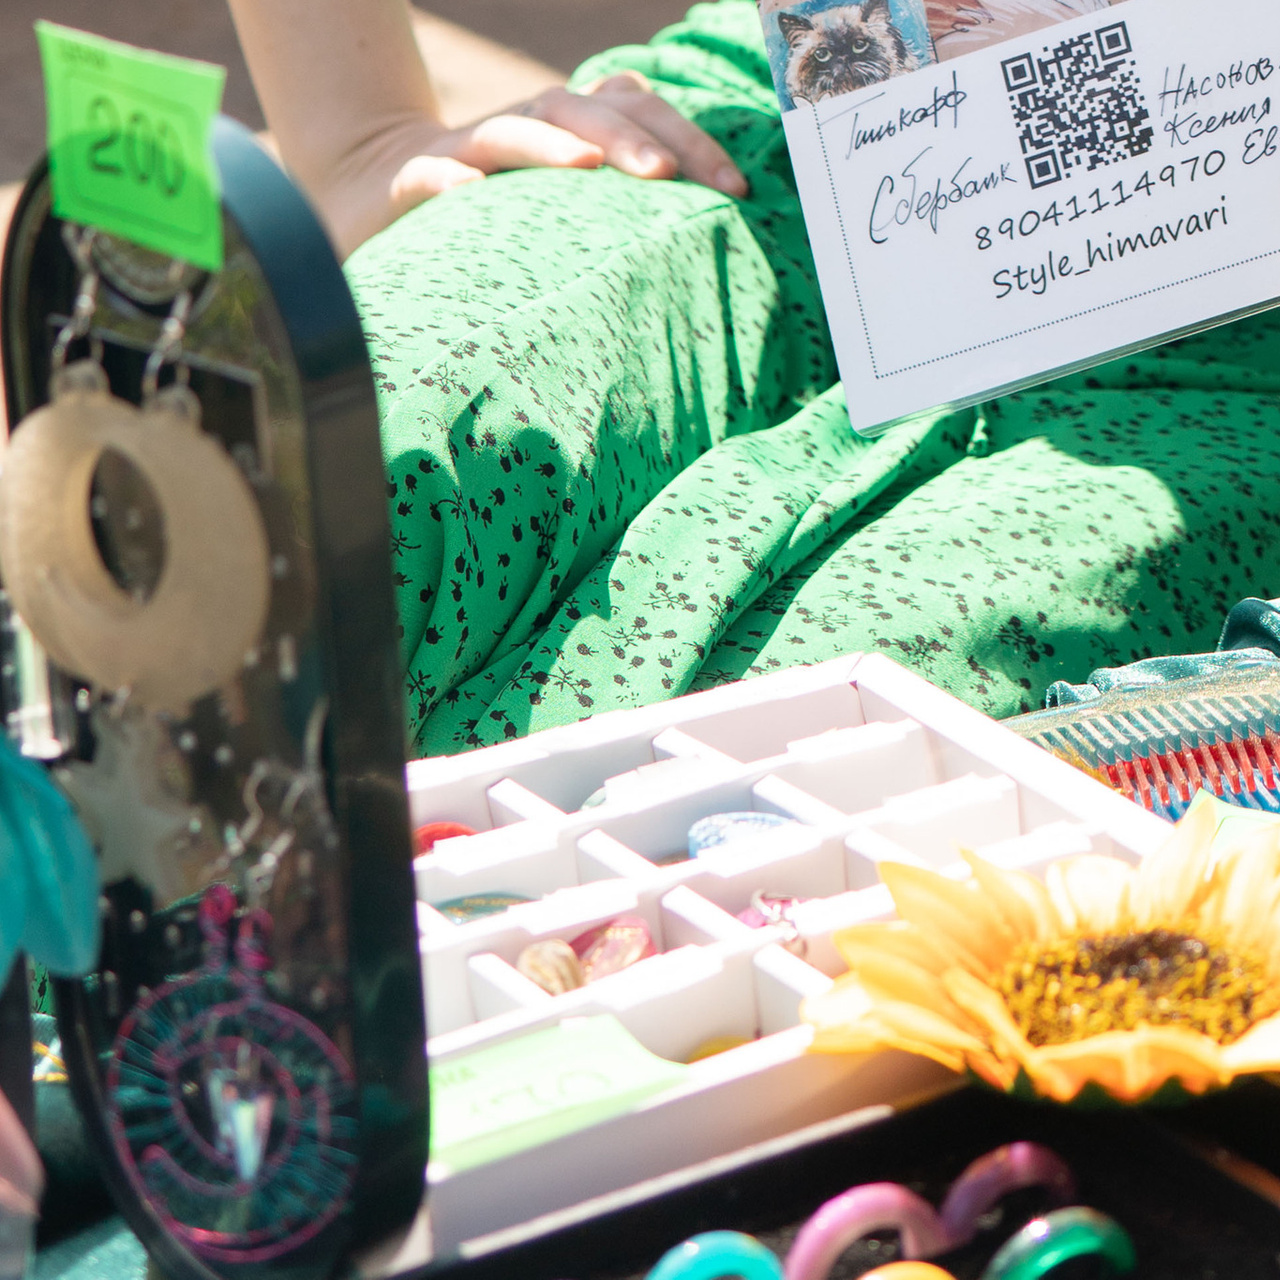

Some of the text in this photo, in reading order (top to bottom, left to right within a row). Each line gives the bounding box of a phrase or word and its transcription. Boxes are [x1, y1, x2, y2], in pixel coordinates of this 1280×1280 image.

[85, 95, 188, 199] 200
[1163, 96, 1272, 149] Ксения
[869, 145, 1018, 245] Сбербанк
[974, 149, 1227, 251] 89041114970
[992, 194, 1229, 300] Style_himavari
